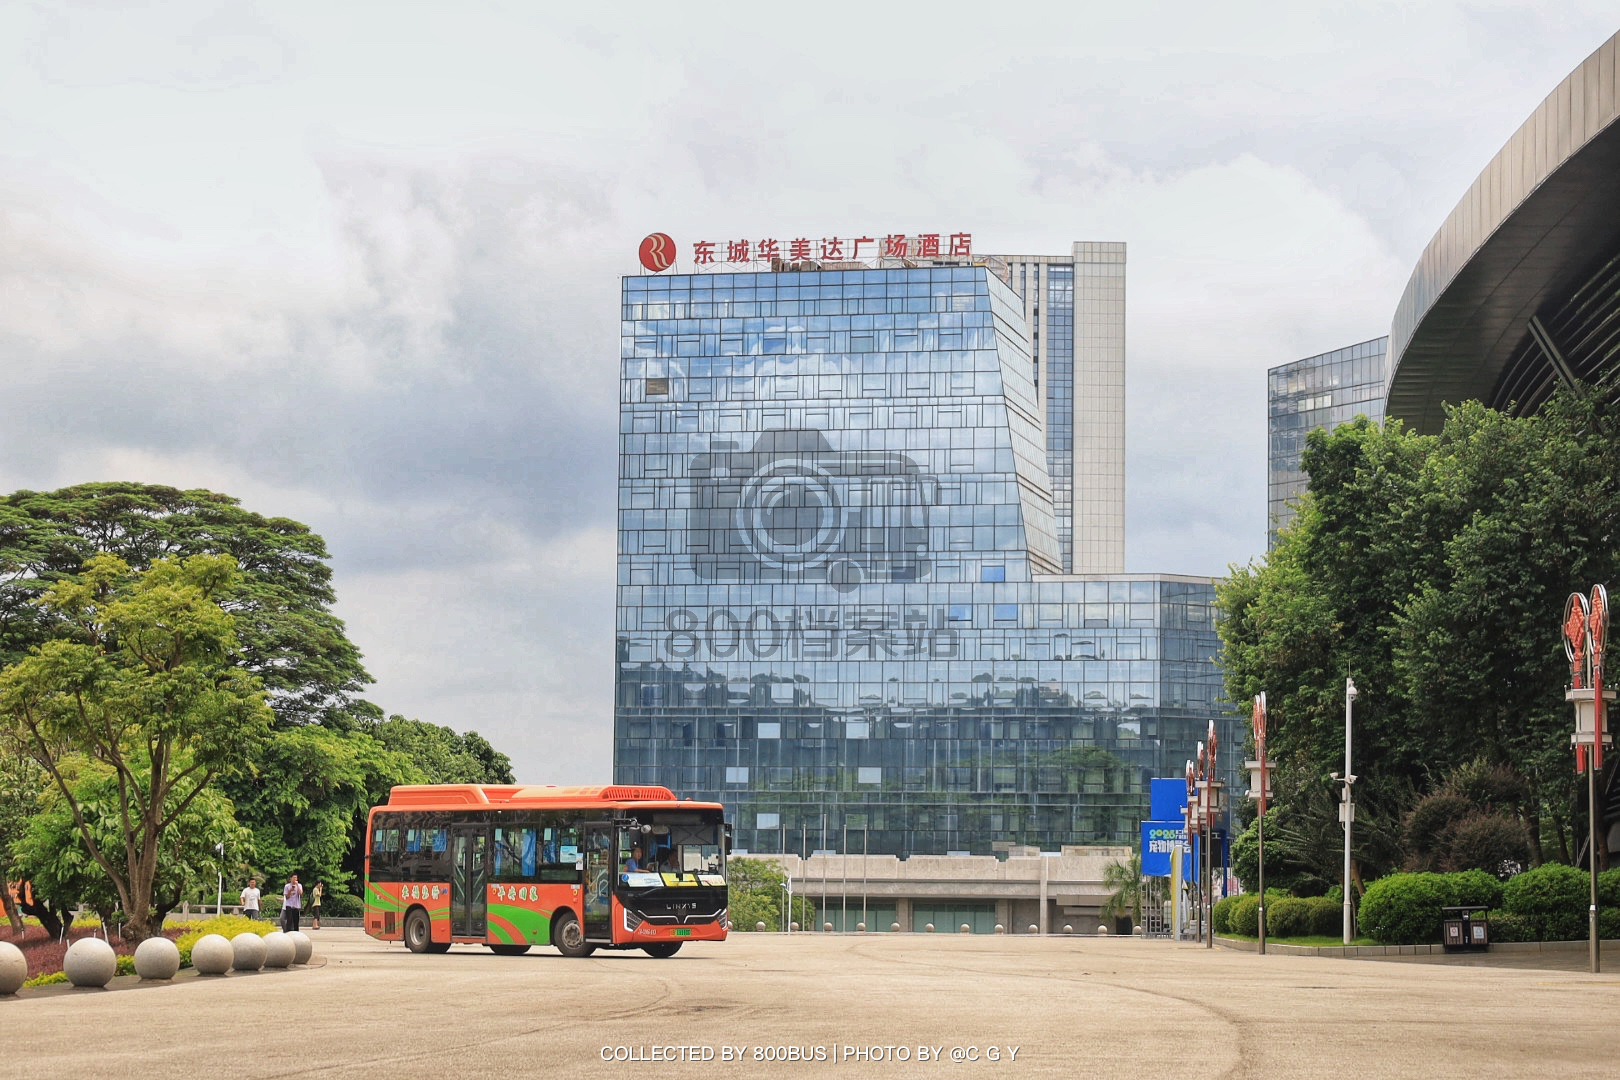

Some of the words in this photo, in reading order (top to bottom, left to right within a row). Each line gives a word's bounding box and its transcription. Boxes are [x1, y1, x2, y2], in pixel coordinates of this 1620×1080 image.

[692, 232, 973, 265] 东城华美达广场酒店
